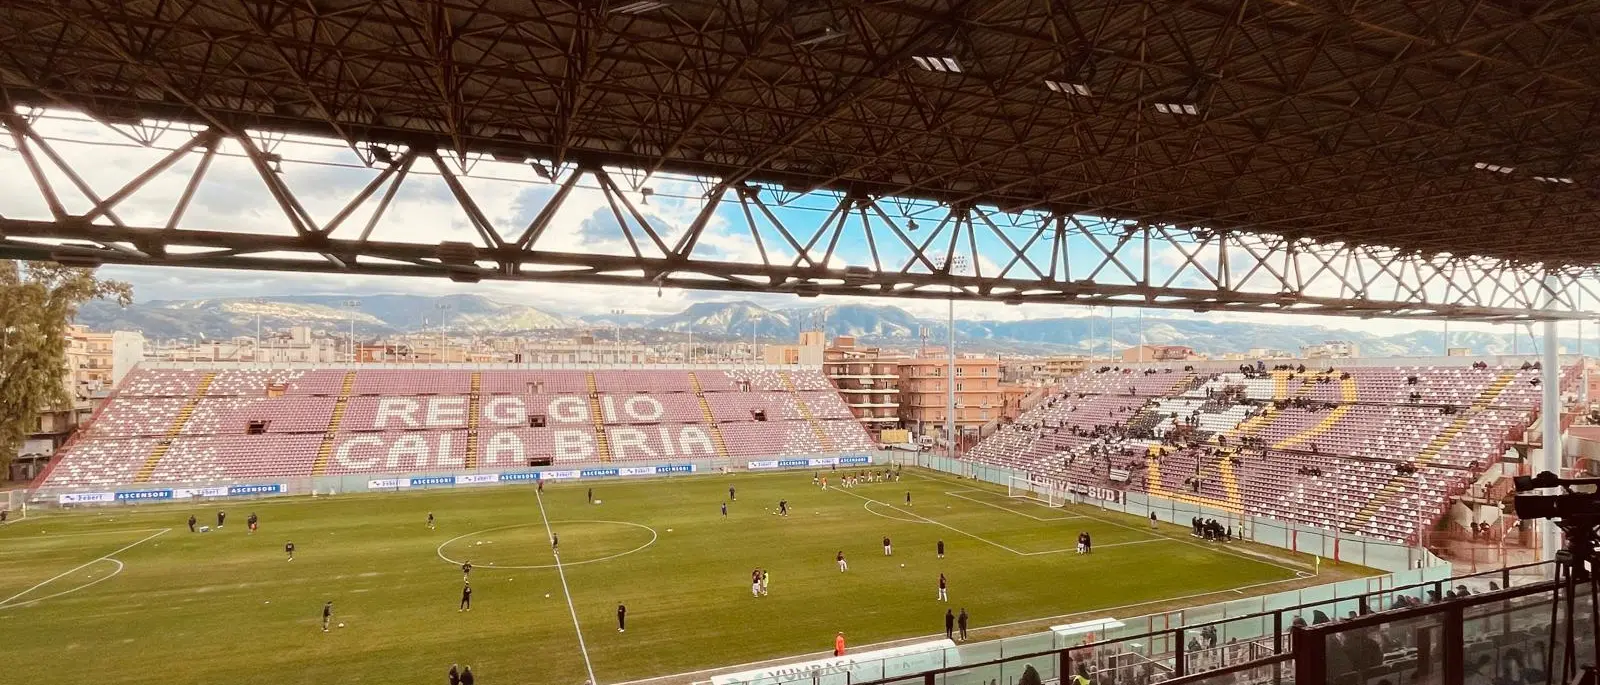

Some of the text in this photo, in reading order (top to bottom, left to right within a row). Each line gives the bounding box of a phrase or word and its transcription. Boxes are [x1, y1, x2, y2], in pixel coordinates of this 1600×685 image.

[375, 393, 664, 428] REGGIO
[336, 425, 718, 470] CALABRIA
[118, 491, 168, 500] ASCENSORI
[231, 486, 276, 494] ASCENSORI
[1087, 485, 1115, 502] SUD
